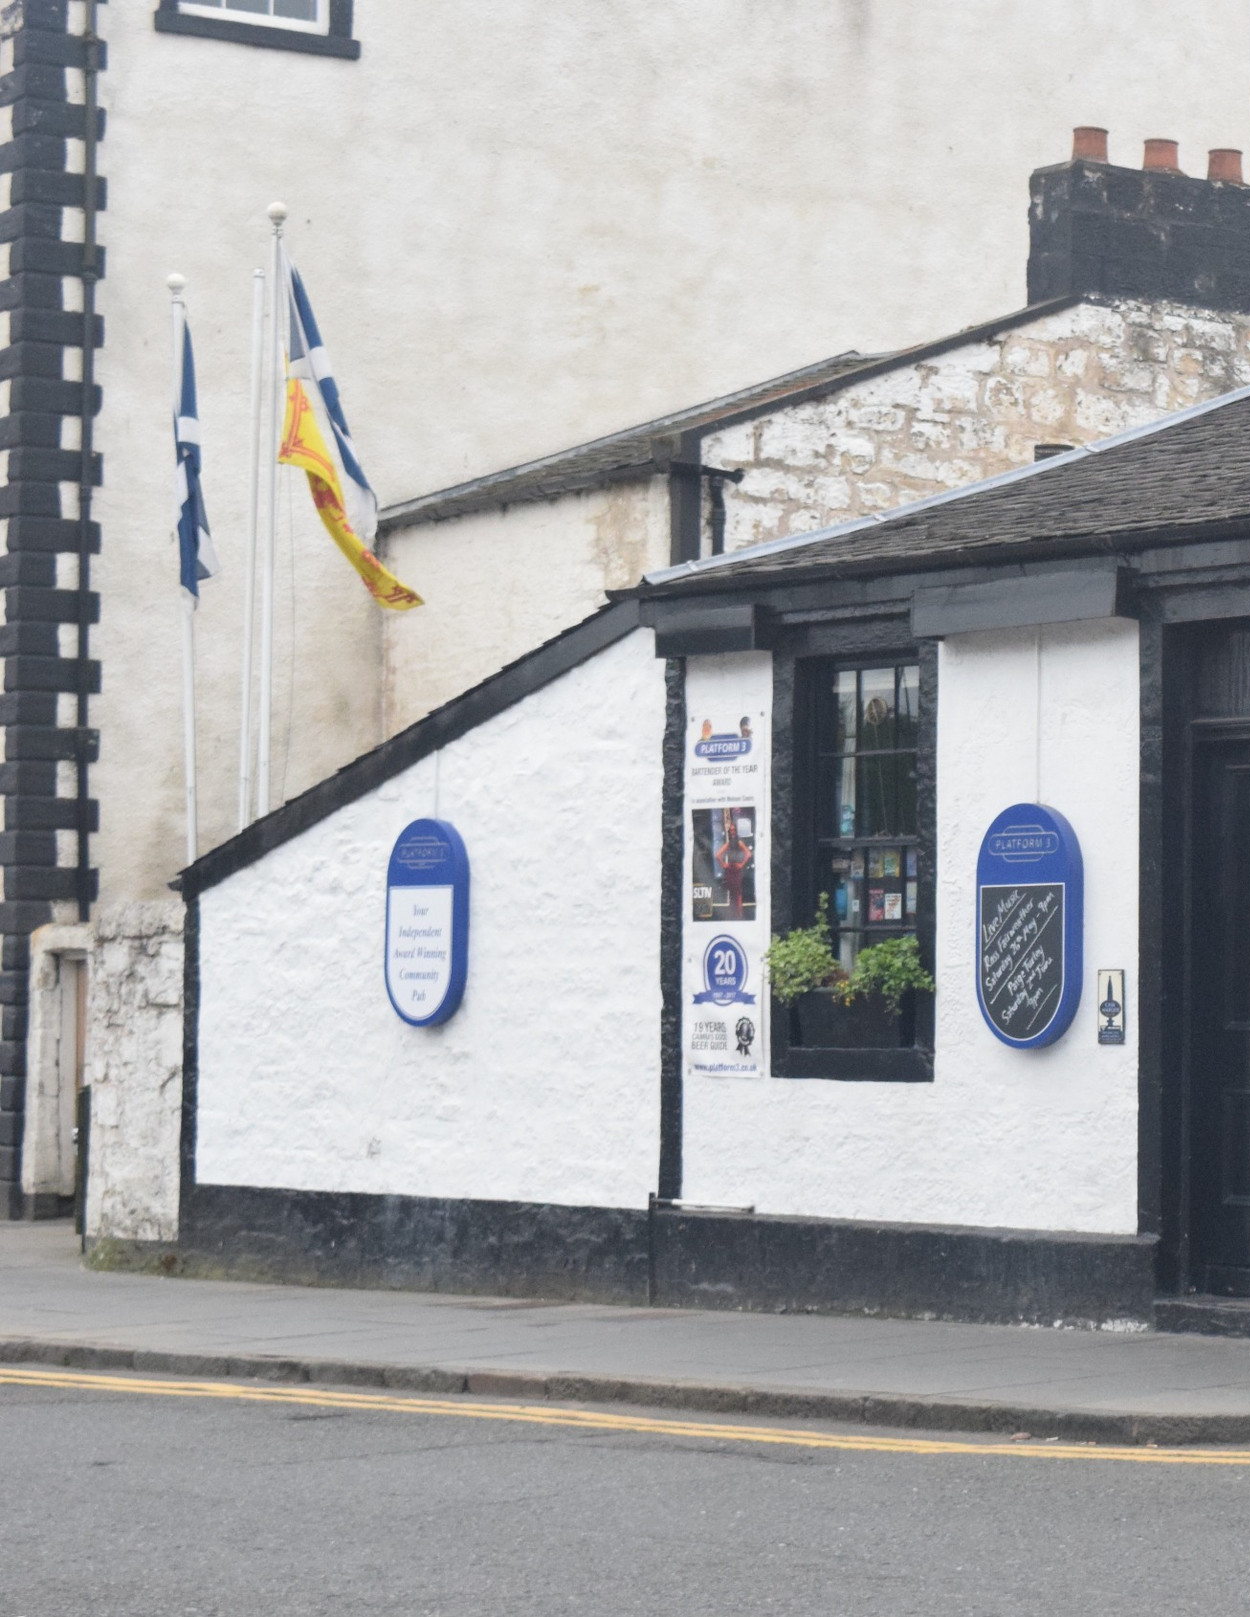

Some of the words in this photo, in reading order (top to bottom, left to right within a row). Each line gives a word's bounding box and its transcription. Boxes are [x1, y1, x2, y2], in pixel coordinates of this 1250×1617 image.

[700, 742, 740, 753] PLATFORM
[741, 741, 747, 751] 3
[692, 767, 721, 776] BARTENDER
[723, 766, 730, 774] OF
[732, 765, 741, 774] THE
[743, 764, 758, 773] YEAR
[995, 838, 1042, 850] PLATFORM
[1046, 838, 1051, 849] 3
[693, 887, 712, 899] SLTN
[413, 905, 429, 916] Your
[998, 889, 1020, 924] Music
[399, 926, 442, 939] Independent
[394, 948, 415, 959] Award
[418, 947, 447, 960] Winning
[985, 954, 1013, 992] Saturday
[1023, 917, 1038, 942] May
[714, 950, 736, 975] 20
[400, 968, 440, 982] Community
[715, 977, 737, 985] YEARS
[412, 989, 427, 1001] Pub
[1002, 988, 1030, 1025] Saturday
[694, 1021, 704, 1032] 19
[704, 1021, 726, 1032] YEARS
[691, 1041, 708, 1050] BEER
[710, 1041, 728, 1051] GUIDE
